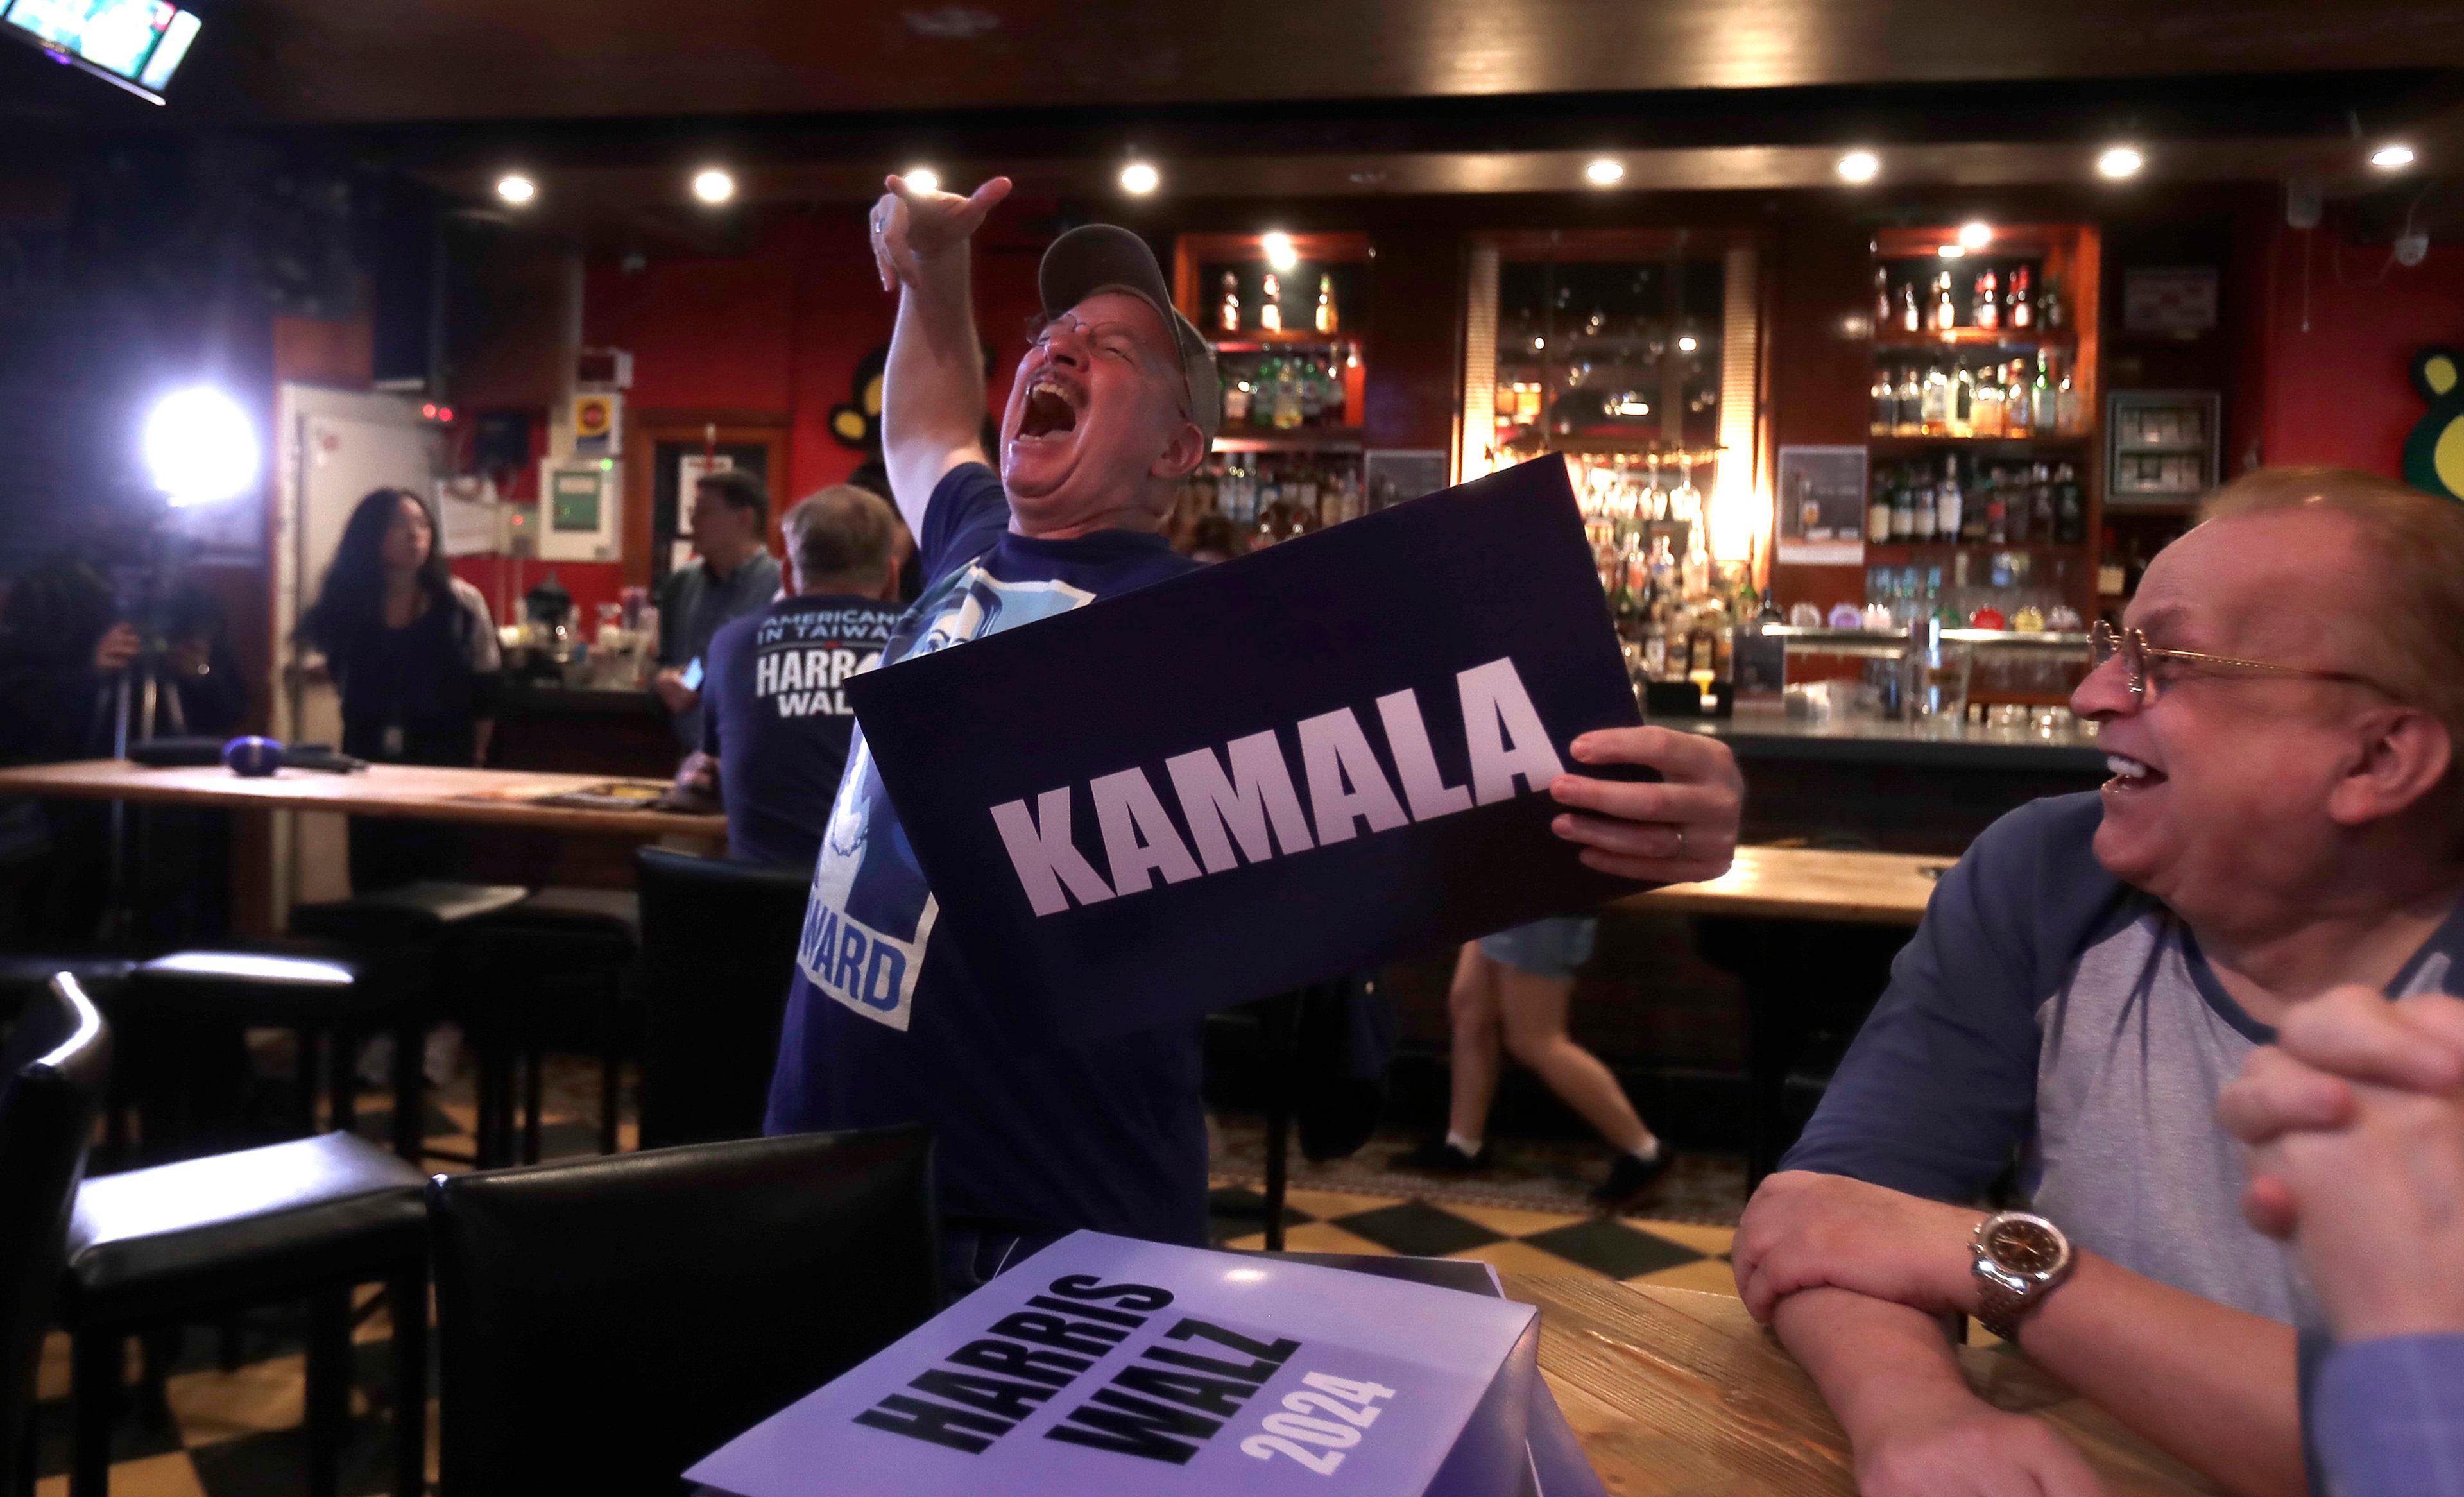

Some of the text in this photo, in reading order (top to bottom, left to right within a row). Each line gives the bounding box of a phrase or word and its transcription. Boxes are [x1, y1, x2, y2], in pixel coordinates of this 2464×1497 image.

[757, 624, 890, 645] IN TAIWA
[762, 610, 905, 628] AMERICAN
[756, 649, 857, 697] HARR
[777, 690, 855, 718] WAL
[990, 656, 1565, 918] KAMALA
[803, 896, 907, 1011] WARD
[851, 1274, 1174, 1455] HARRIS
[1043, 1317, 1303, 1466] WALZ
[1240, 1371, 1396, 1476] 2024
